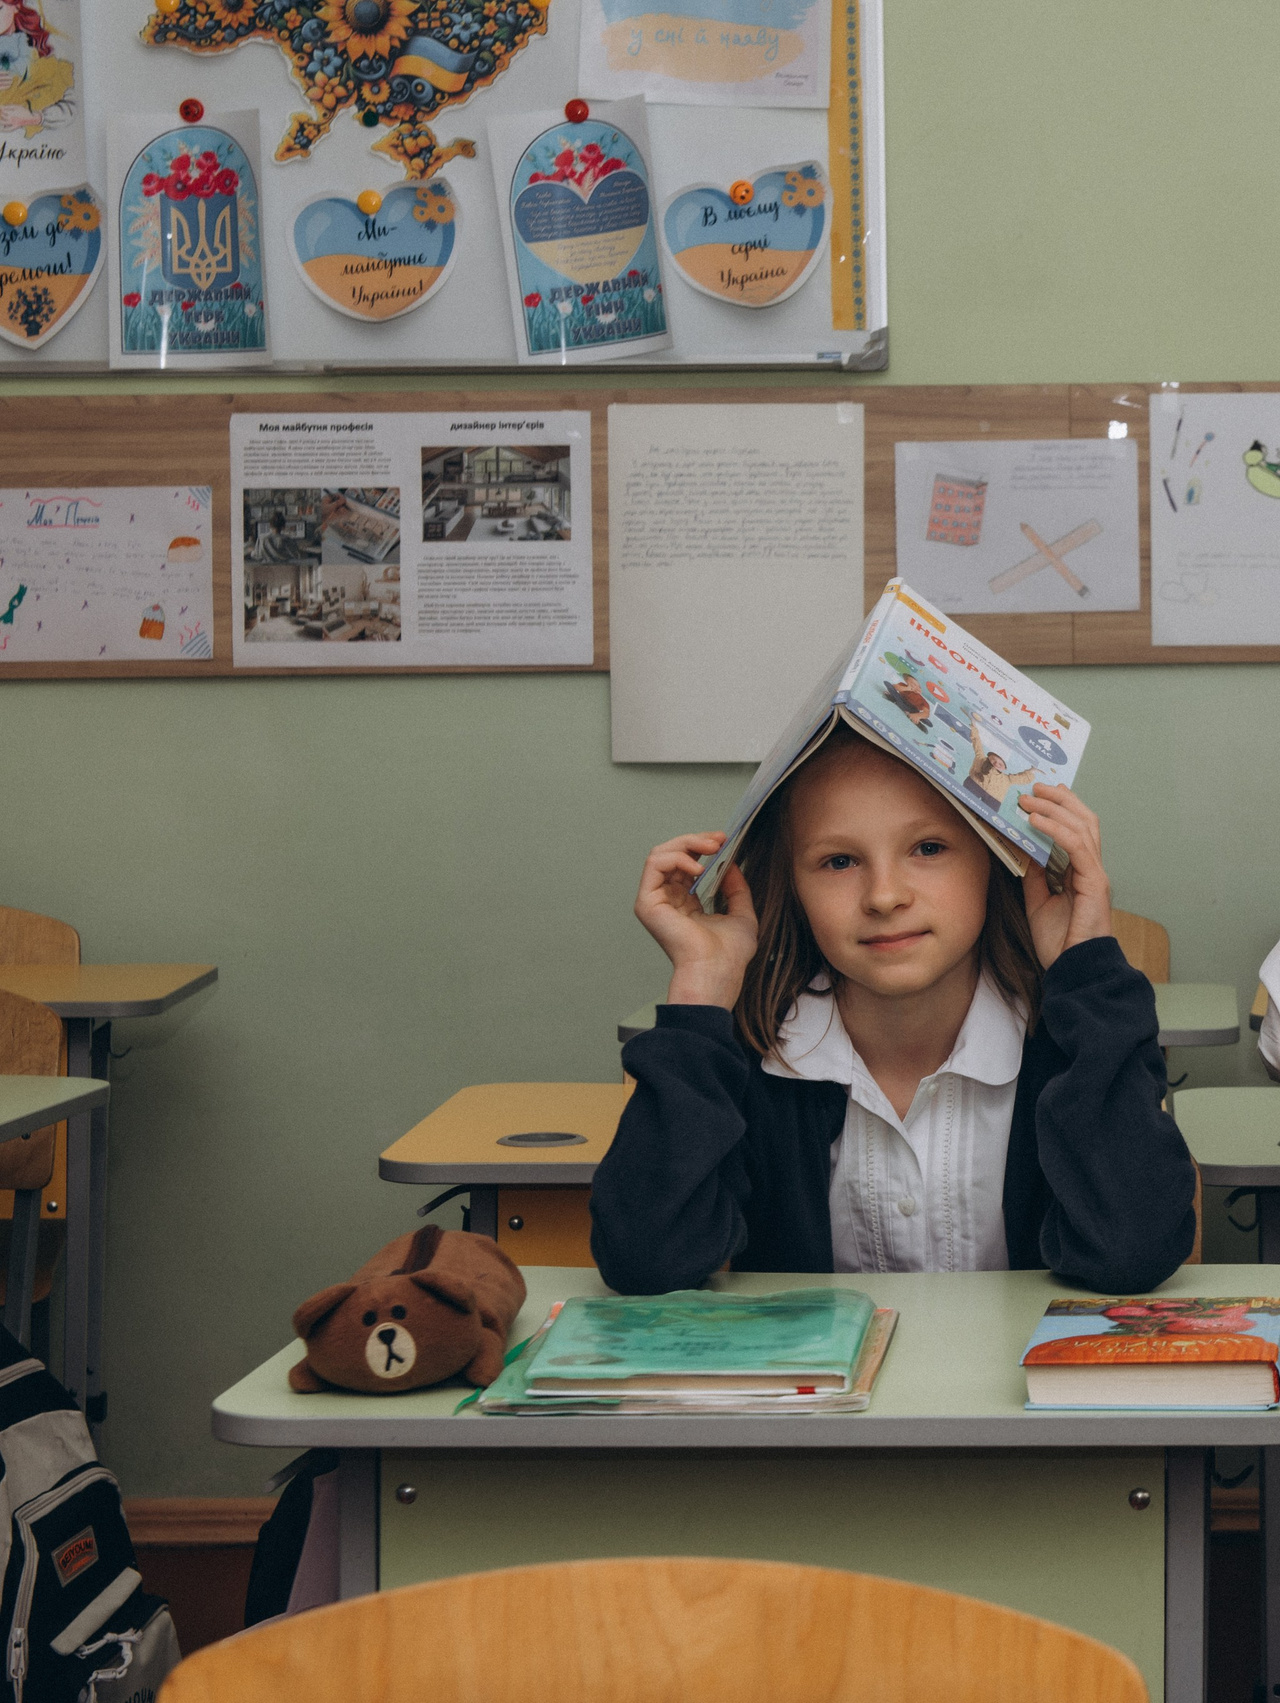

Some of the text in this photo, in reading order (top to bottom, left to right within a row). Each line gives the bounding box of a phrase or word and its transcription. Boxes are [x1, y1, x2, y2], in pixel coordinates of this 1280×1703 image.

[627, 29, 643, 56] у
[654, 27, 684, 47] сні
[720, 28, 779, 61] наяву
[700, 200, 781, 228] В моєму
[45, 221, 66, 247] до
[731, 233, 772, 262] серці
[340, 251, 428, 279] майбутнє
[549, 268, 649, 304] ДЕРЖАВНИЙ
[718, 266, 789, 292] Україна
[148, 282, 252, 306] ДЕРЖАВНИЙ
[351, 279, 424, 310] України!
[168, 328, 240, 346] УКРАЇНИ
[572, 318, 642, 342] УКРАЇНИ
[259, 421, 374, 433] Моя майбутня професія
[450, 420, 497, 431] дизайнер
[909, 617, 1063, 741] ІНФОРМАТИКА
[1029, 738, 1053, 759] КЛАС
[1037, 737, 1053, 752] 4
